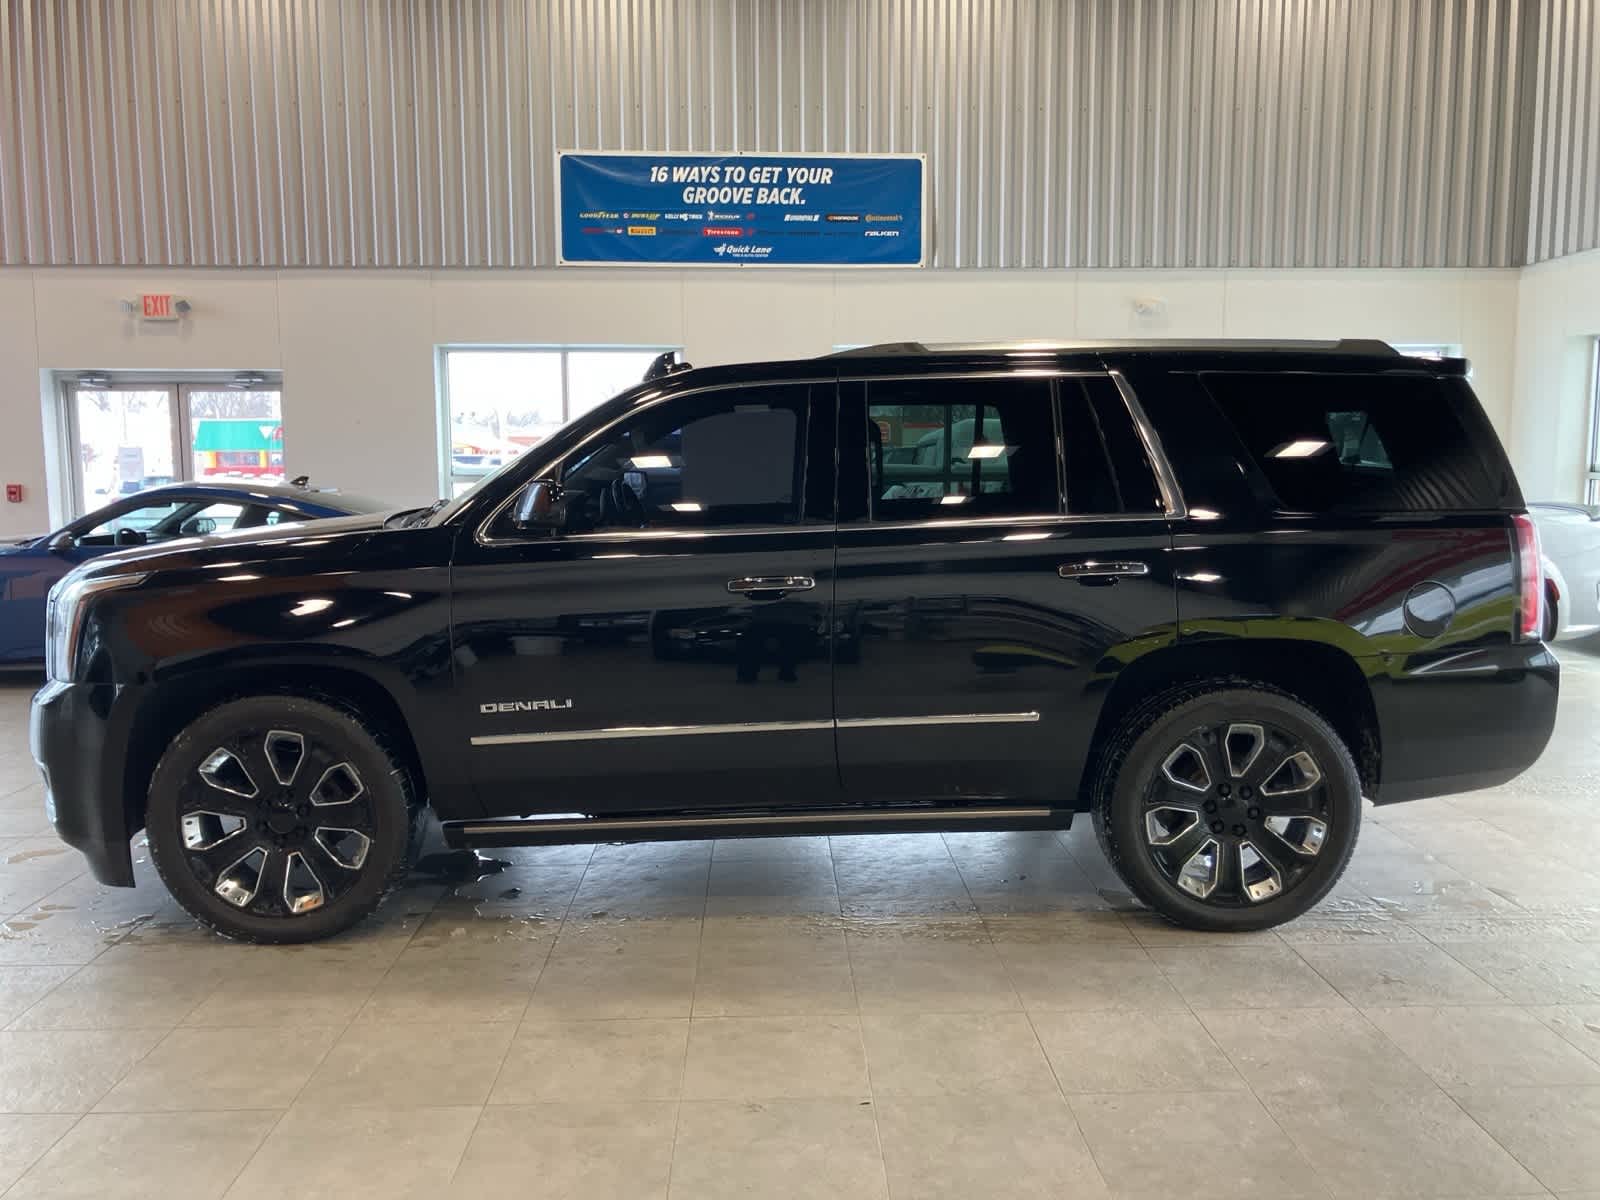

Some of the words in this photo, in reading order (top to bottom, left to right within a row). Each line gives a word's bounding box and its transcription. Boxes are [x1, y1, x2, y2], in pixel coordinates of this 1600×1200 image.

[650, 166, 669, 183] 16
[673, 166, 721, 183] WAYS
[724, 166, 746, 184] TO
[749, 167, 782, 184] GET
[787, 167, 833, 185] YOUR
[683, 187, 754, 204] GROOVE
[756, 187, 806, 205] BACK.
[726, 245, 750, 254] Quick
[750, 245, 773, 254] Lane
[143, 295, 171, 317] EXIT
[480, 699, 572, 713] DENALI
